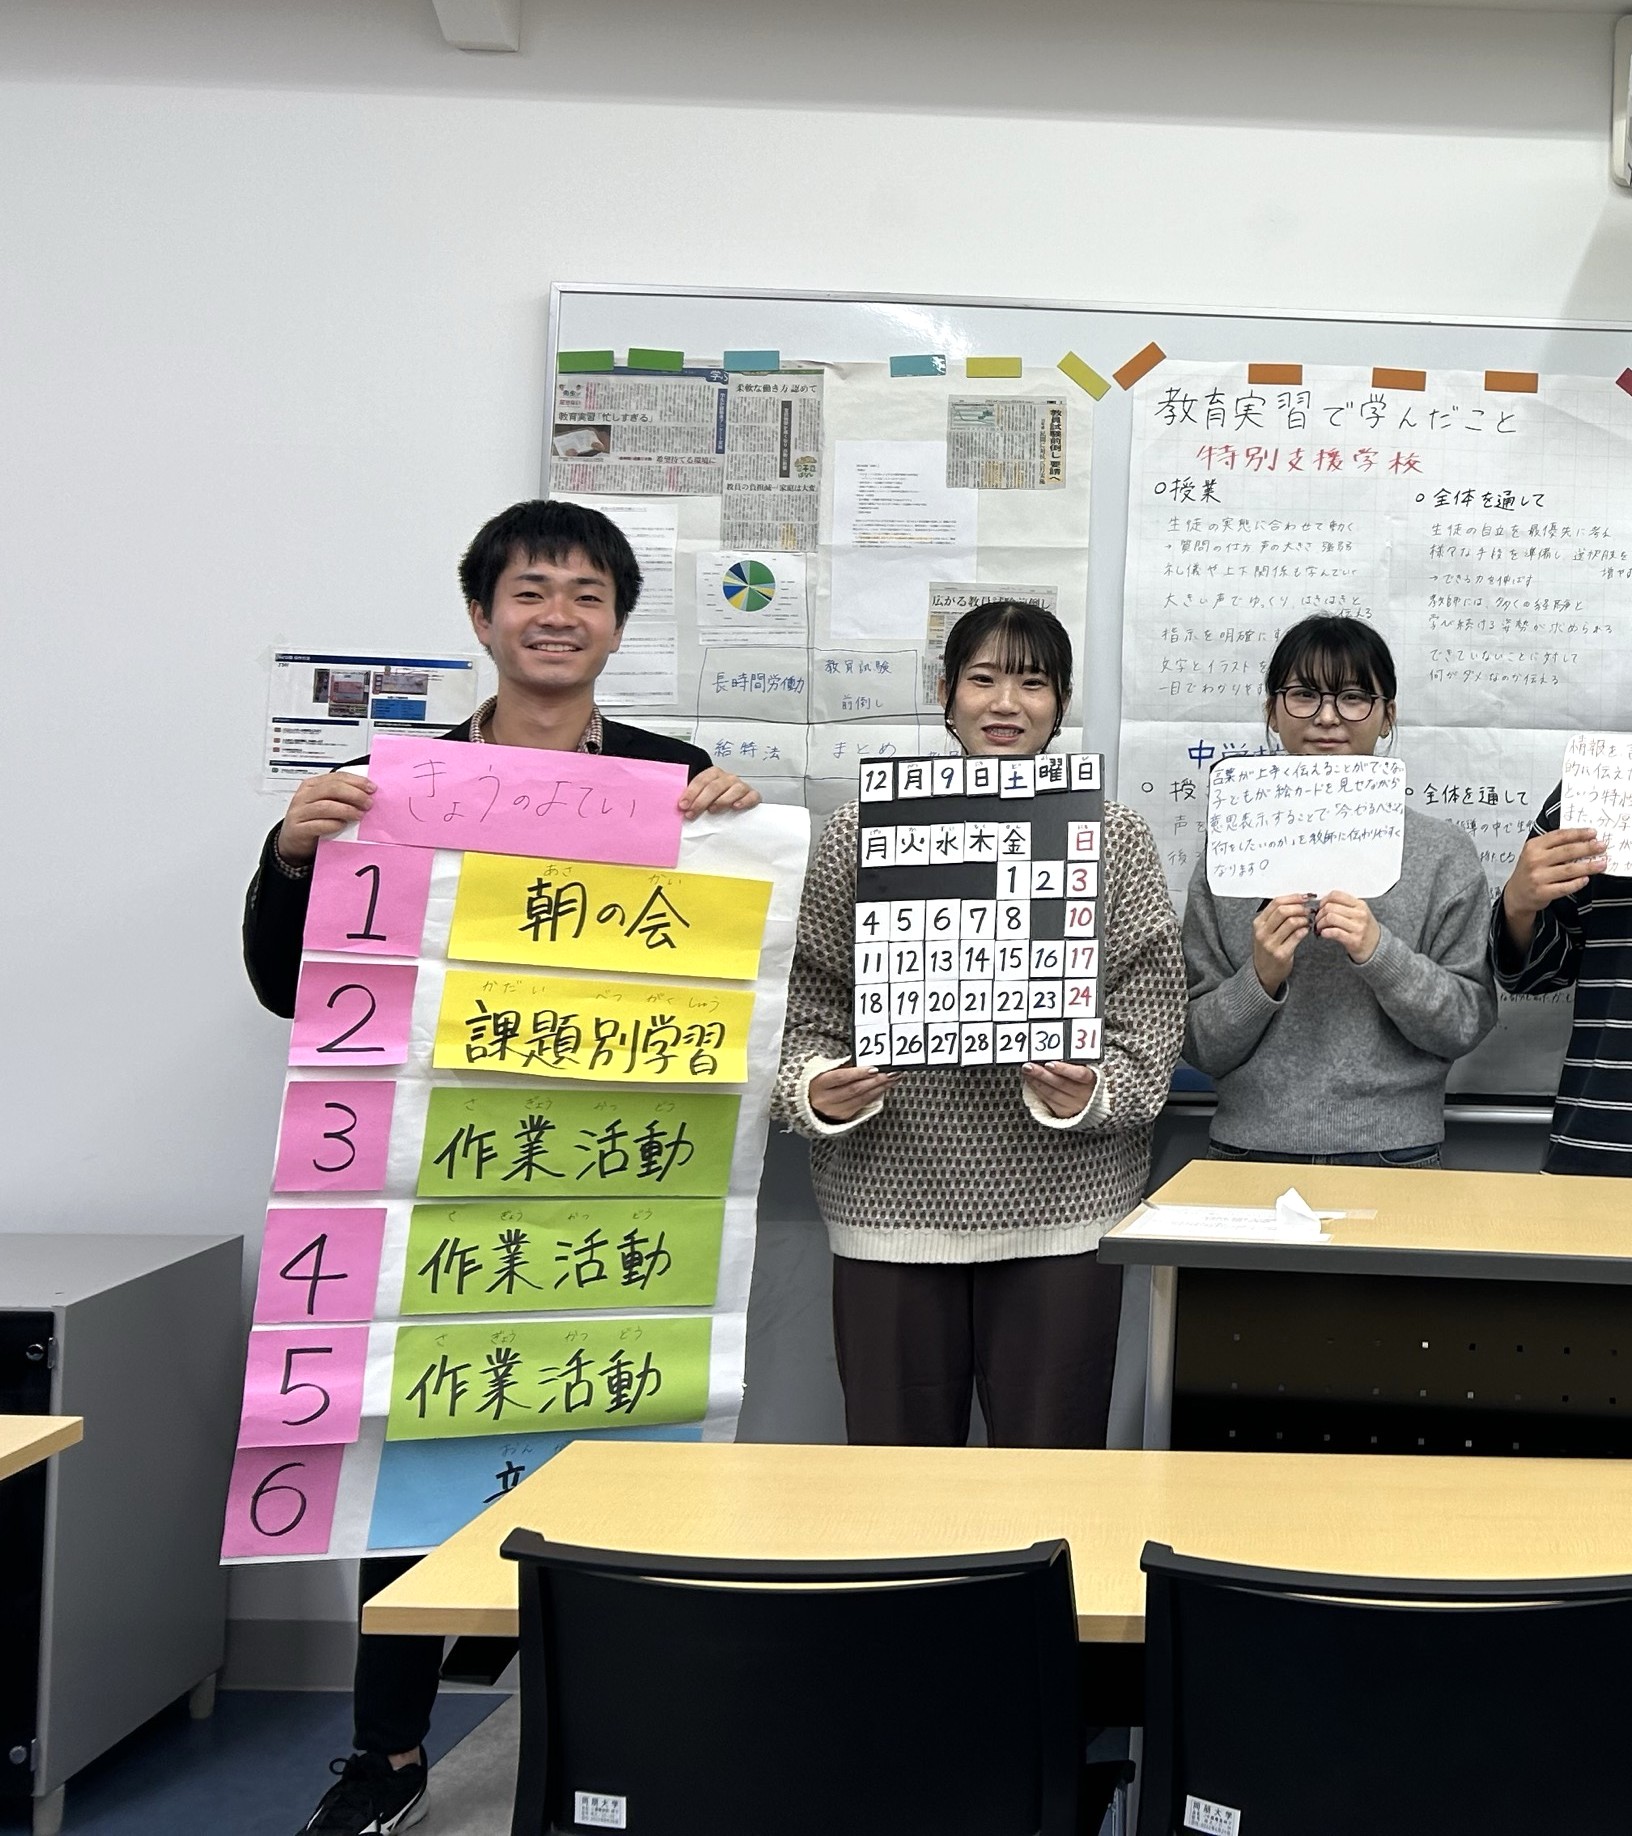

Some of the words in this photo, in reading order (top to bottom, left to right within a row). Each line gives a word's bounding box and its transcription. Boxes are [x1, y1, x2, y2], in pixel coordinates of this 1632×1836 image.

[1155, 387, 1518, 432] 教育実習で学んだこと
[1196, 444, 1424, 475] 特別支援学校
[833, 741, 897, 760] まとめ
[408, 759, 636, 823] きょうのよてい
[1423, 782, 1529, 806] 全体を通して
[865, 836, 888, 860] 月
[900, 832, 925, 854] 火
[936, 831, 959, 856] 水
[969, 829, 996, 853] 木
[1002, 828, 1026, 856] 金
[1075, 830, 1094, 851] 日
[1007, 866, 1017, 894] 1
[1039, 871, 1055, 891] 2
[1072, 868, 1087, 891] 3
[345, 863, 388, 943] 1
[518, 877, 691, 949] 朝の会
[862, 910, 880, 936] 4
[897, 908, 913, 931] 5
[933, 907, 951, 931] 6
[969, 907, 987, 934] 7
[1006, 907, 1022, 931] 8
[1068, 907, 1092, 928] 10
[863, 953, 882, 974] 11
[897, 950, 920, 975] 12
[930, 951, 952, 974] 13
[965, 947, 990, 973] 14
[1000, 948, 1022, 973] 15
[1035, 948, 1058, 969] 16
[1071, 947, 1095, 970] 17
[860, 992, 883, 1015] 18
[897, 990, 919, 1015] 19
[928, 990, 955, 1012] 20
[964, 990, 986, 1012] 21
[997, 990, 1025, 1012] 22
[1033, 990, 1056, 1010] 23
[1068, 985, 1092, 1007] 24
[316, 983, 386, 1055] 2
[465, 999, 726, 1076] 課題別学習
[859, 1032, 887, 1057] 25
[895, 1034, 923, 1056] 26
[931, 1032, 958, 1055] 27
[964, 1032, 990, 1053] 28
[999, 1031, 1027, 1052] 29
[1034, 1030, 1061, 1051] 30
[1074, 1028, 1096, 1050] 31
[312, 1102, 359, 1173] 3
[433, 1114, 695, 1182] 作業活動
[278, 1233, 348, 1316] 4
[417, 1228, 672, 1295] 作業活動
[281, 1347, 334, 1427] 5
[405, 1347, 662, 1420] 作業活動
[249, 1460, 307, 1537] 6
